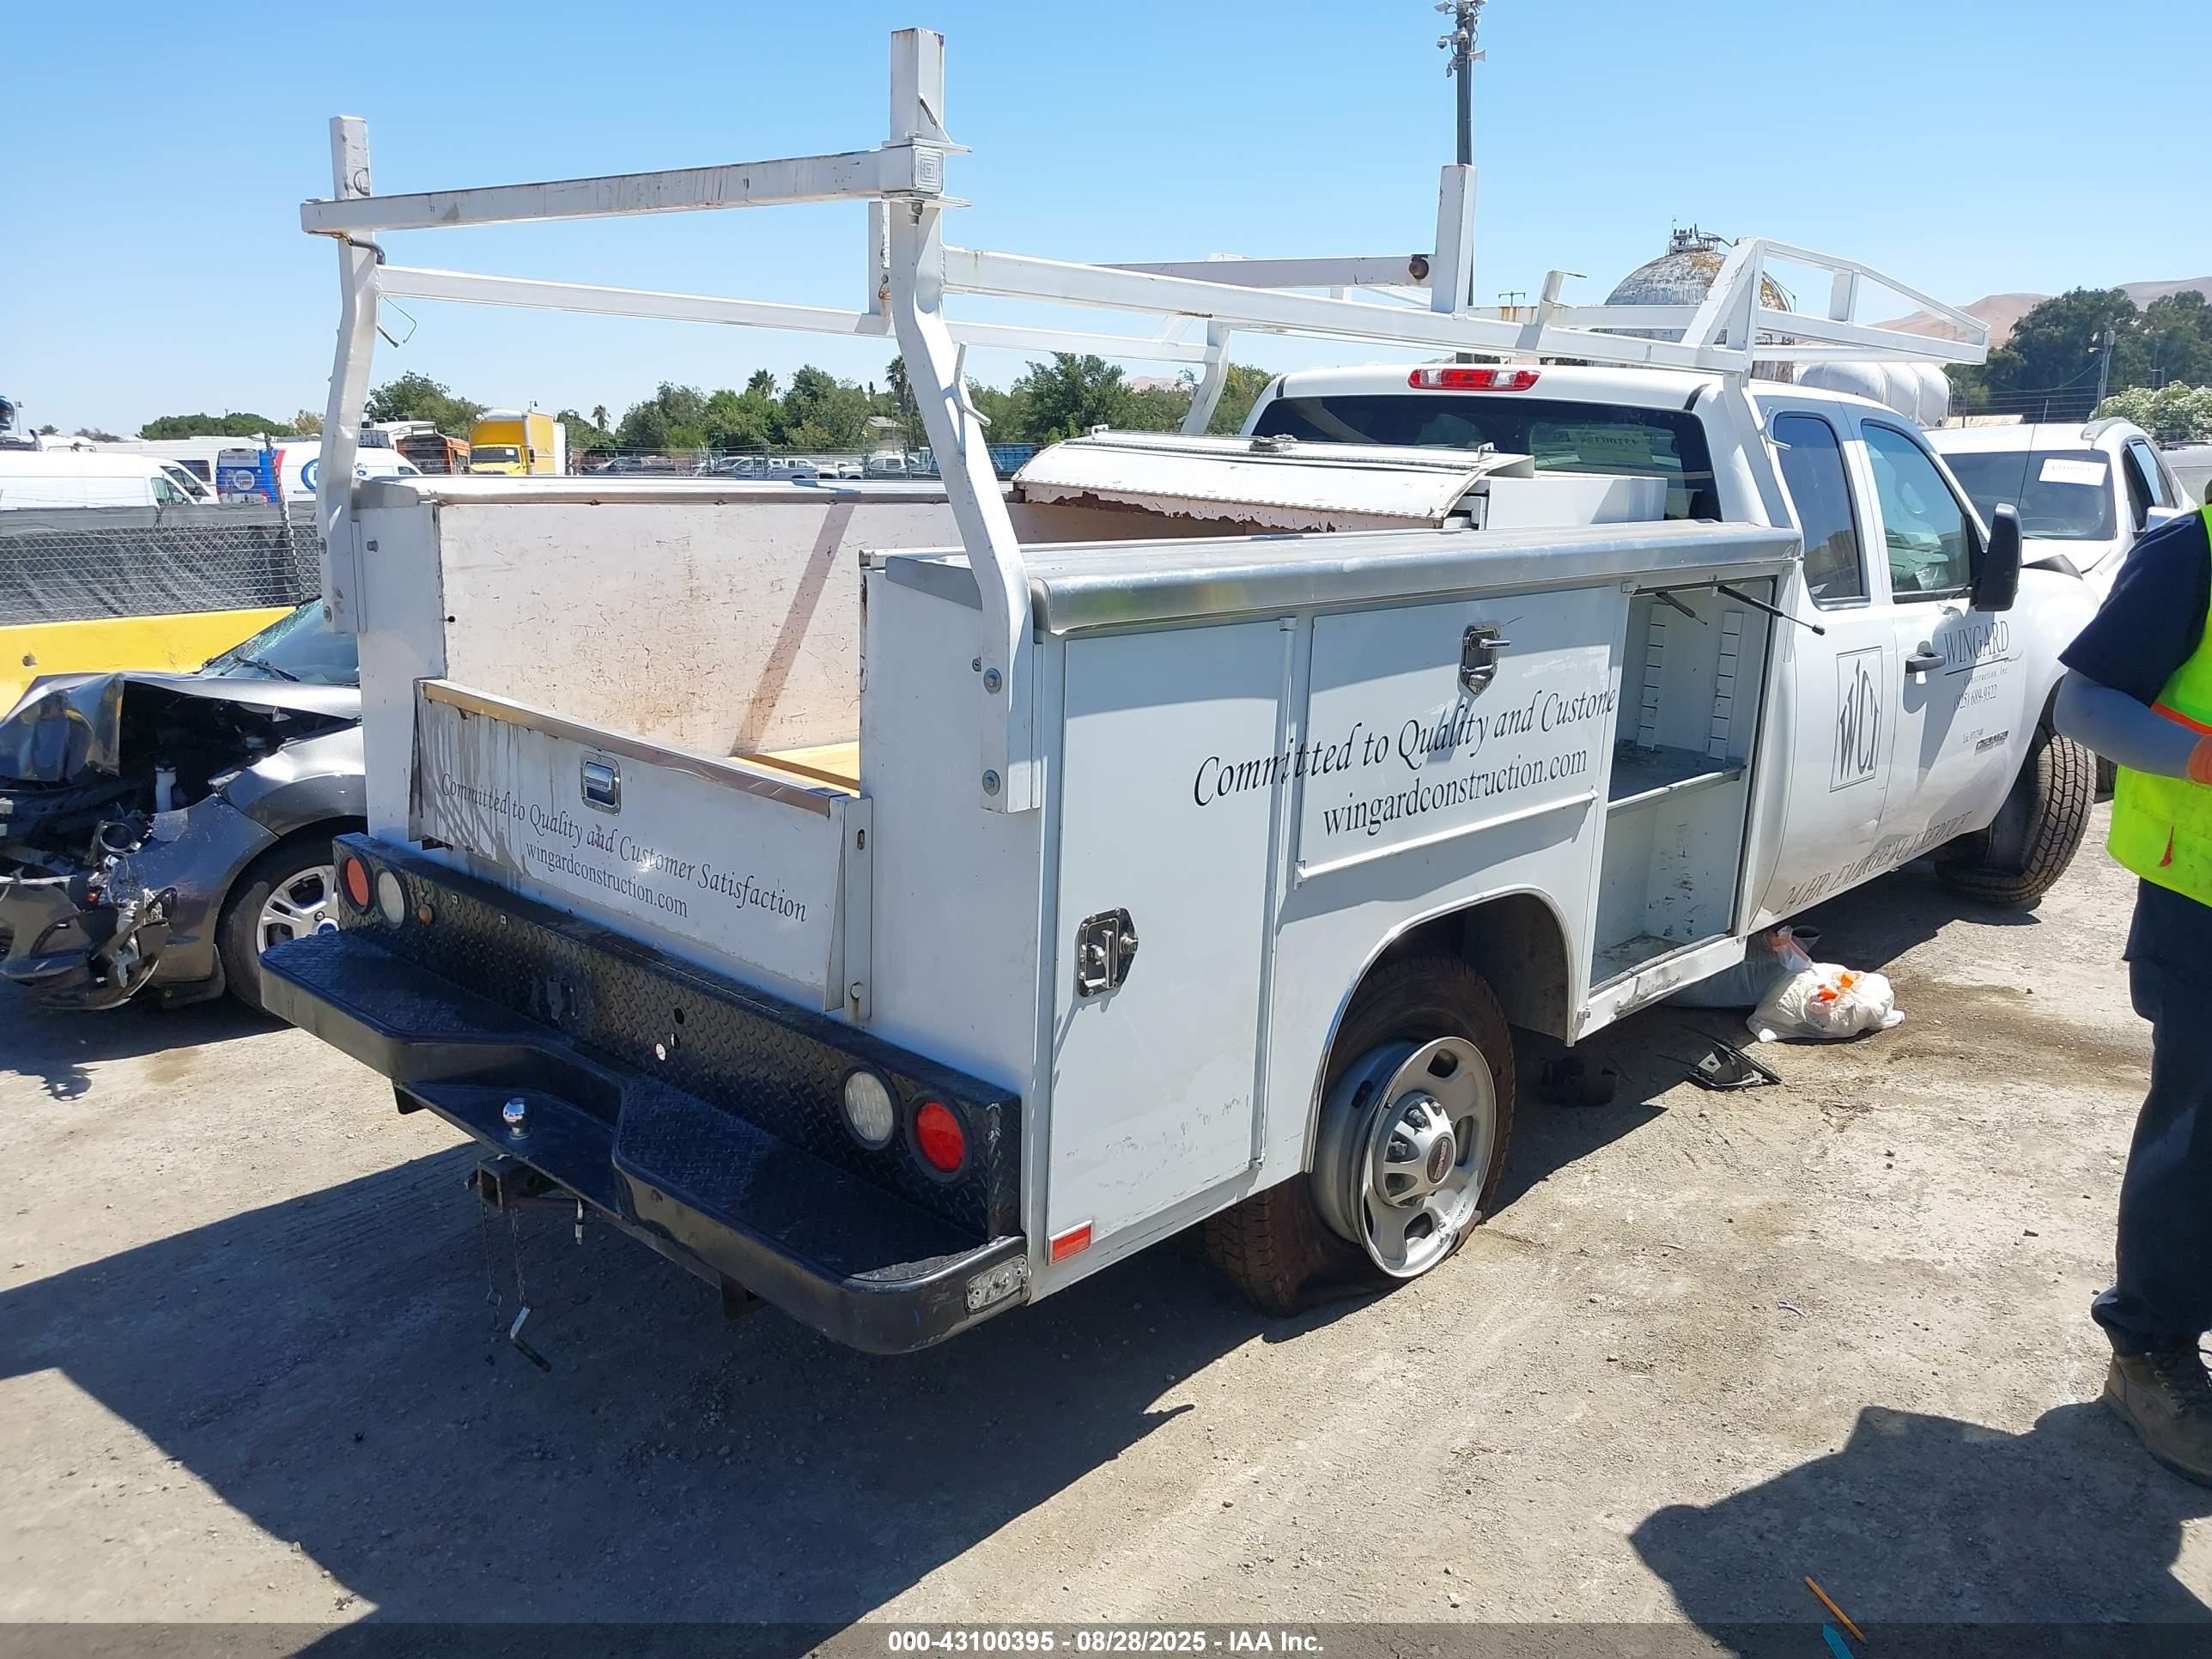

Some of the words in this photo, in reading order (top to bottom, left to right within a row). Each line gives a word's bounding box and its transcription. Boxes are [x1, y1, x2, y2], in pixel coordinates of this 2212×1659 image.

[1944, 620, 2009, 666] WINGARD
[1193, 722, 1364, 807] Committed
[1363, 731, 1389, 767] to
[1398, 703, 1490, 771] Quality
[1493, 689, 1543, 738] and
[1322, 749, 1588, 837] wingardconstruction.com
[441, 773, 511, 815] Committed
[512, 799, 526, 822] to
[529, 803, 583, 849] Quality
[586, 828, 618, 854] and
[619, 835, 696, 882] Customer
[697, 863, 807, 923] Satisfaction
[526, 839, 688, 919] wingardconstruction.com
